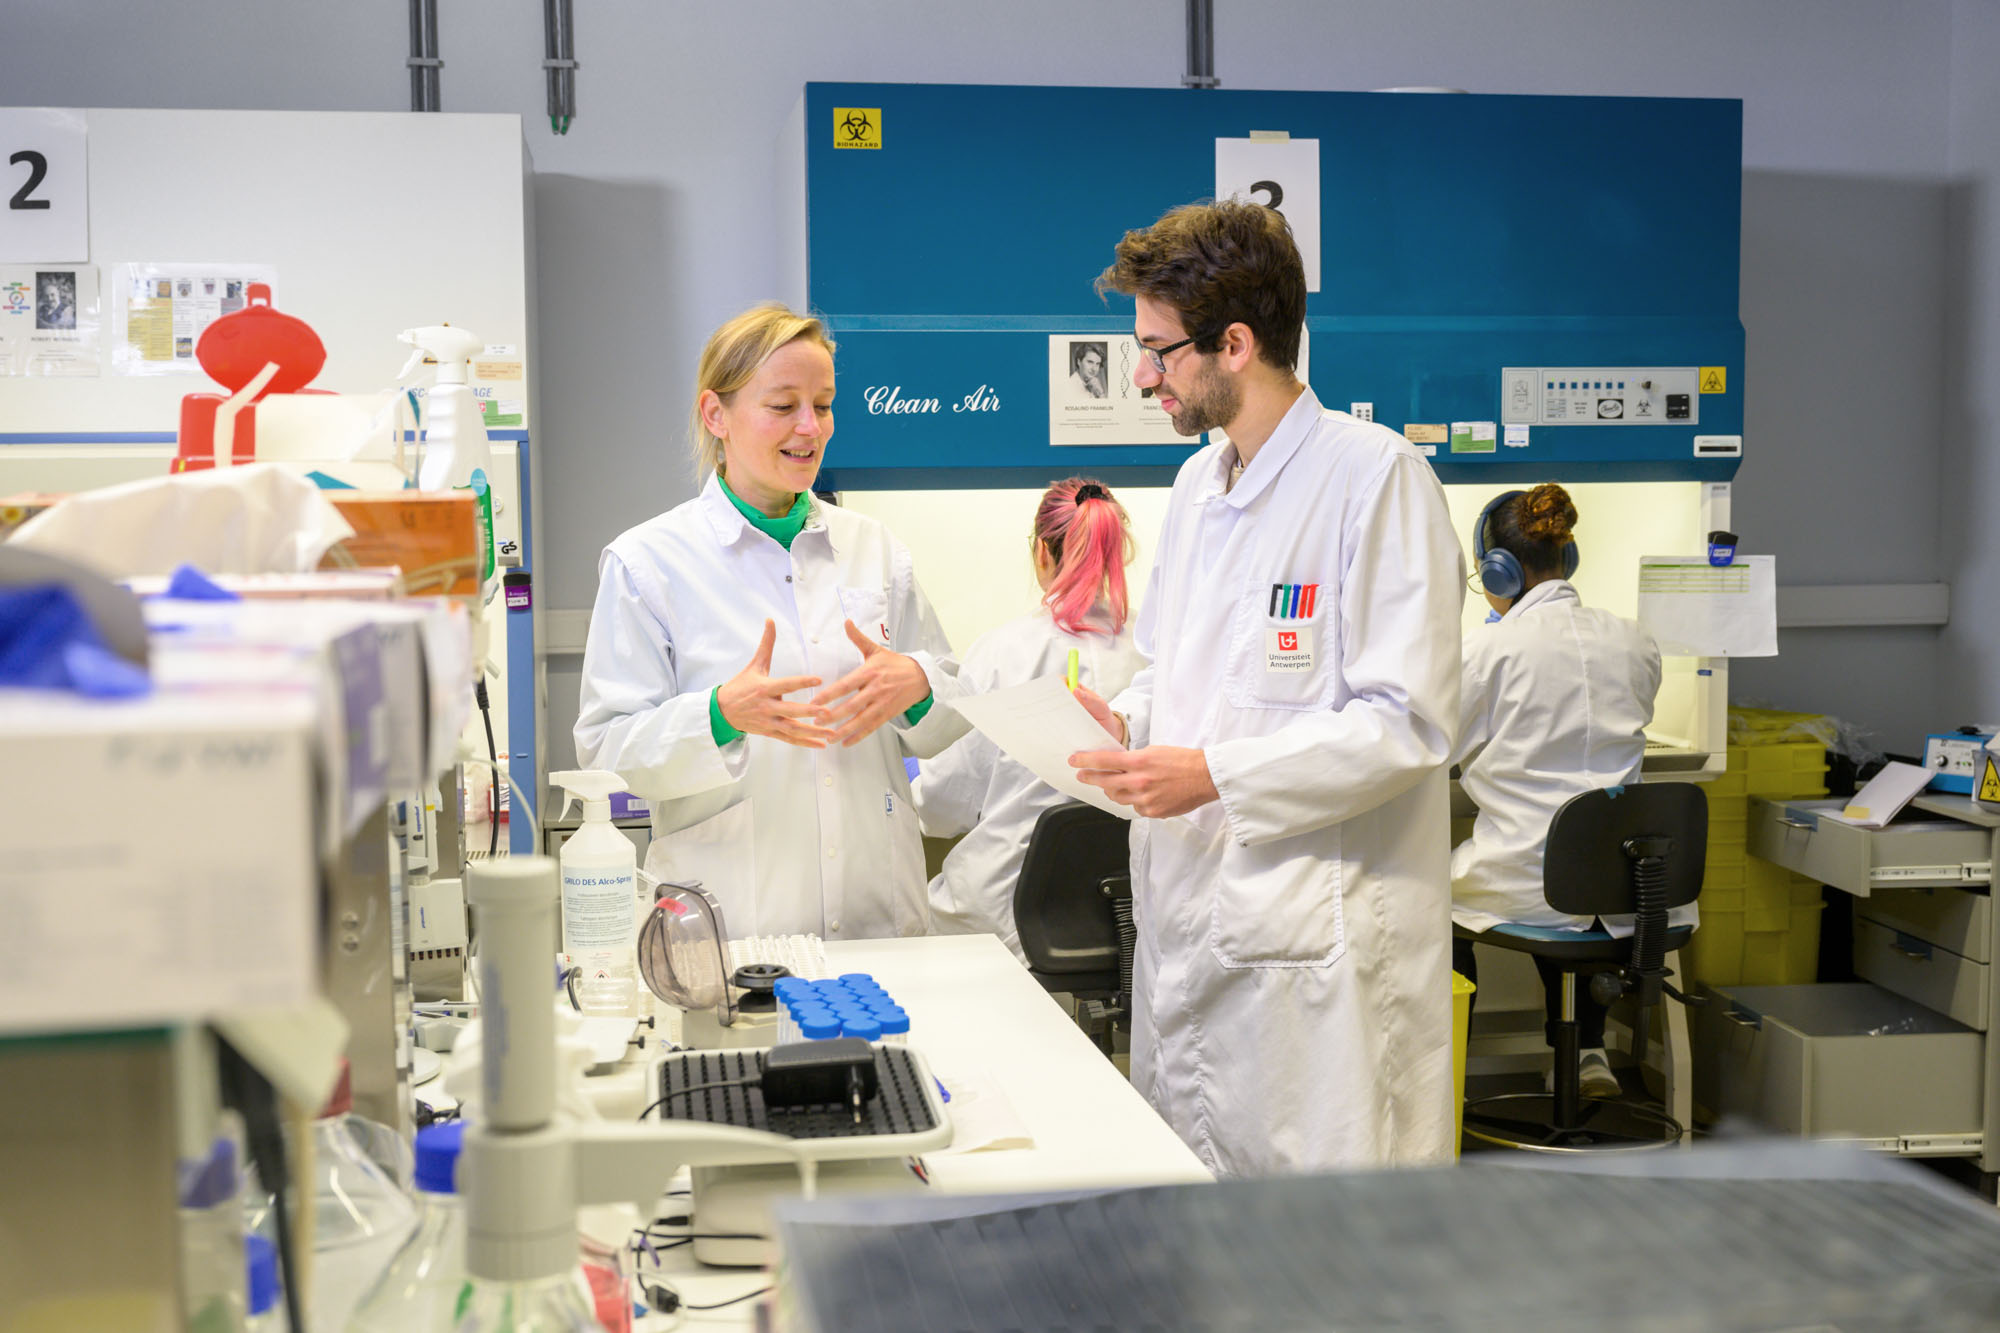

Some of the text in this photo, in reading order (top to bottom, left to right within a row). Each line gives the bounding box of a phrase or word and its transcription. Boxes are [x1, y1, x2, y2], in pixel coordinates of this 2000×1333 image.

[9, 150, 50, 210] 2
[863, 384, 1001, 415] Clean Air
[1269, 653, 1311, 661] Universiteit
[1270, 661, 1311, 669] Antwerpen
[582, 878, 597, 886] DES
